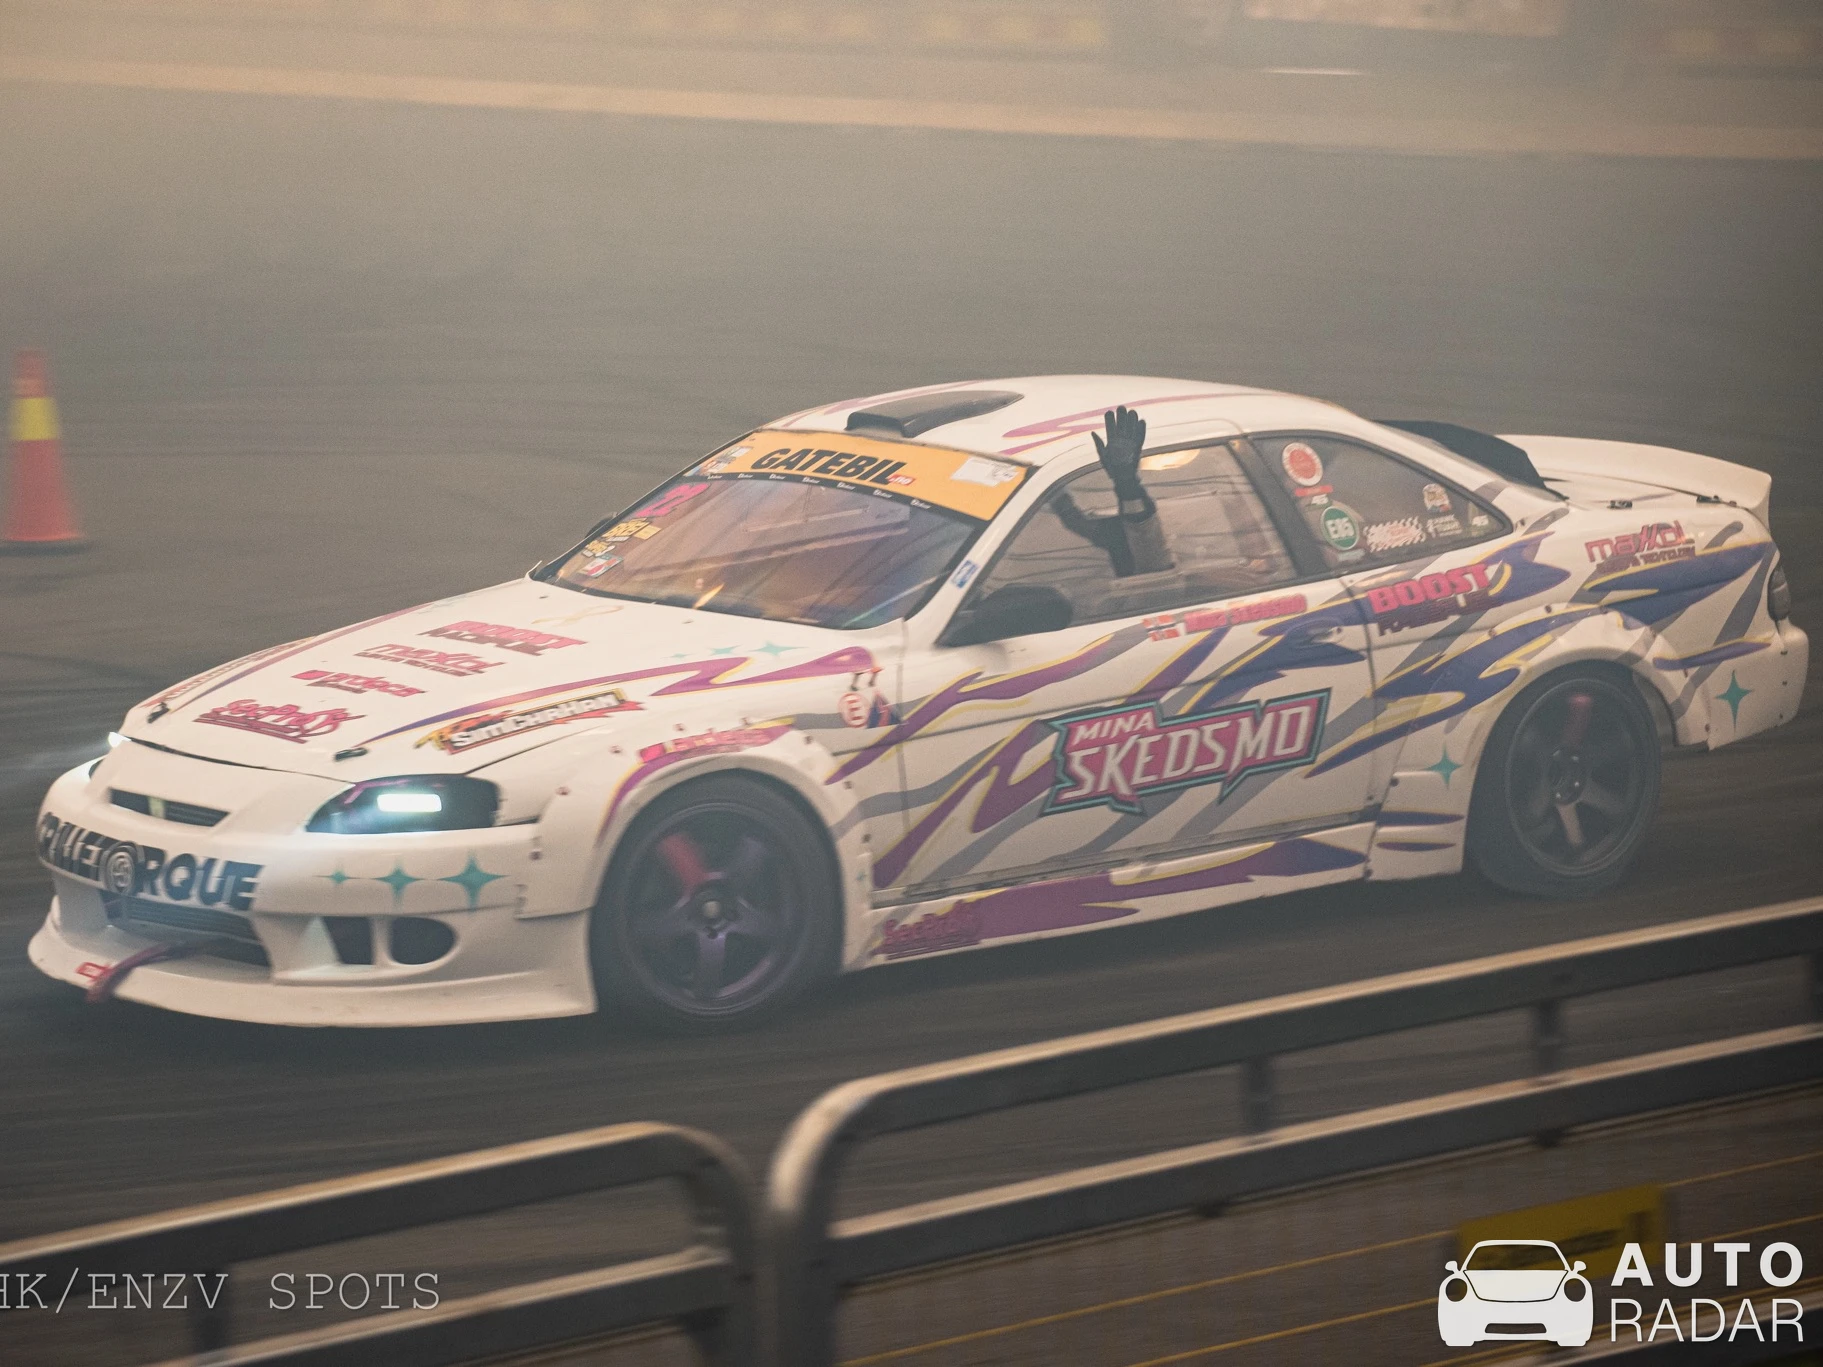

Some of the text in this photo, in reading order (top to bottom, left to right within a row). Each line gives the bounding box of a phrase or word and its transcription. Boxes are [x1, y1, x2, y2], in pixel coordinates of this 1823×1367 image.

[751, 448, 906, 485] GATEBIL
[1367, 564, 1490, 613] BOOST
[1070, 711, 1154, 746] MINA
[1060, 704, 1312, 799] SKEDSMO
